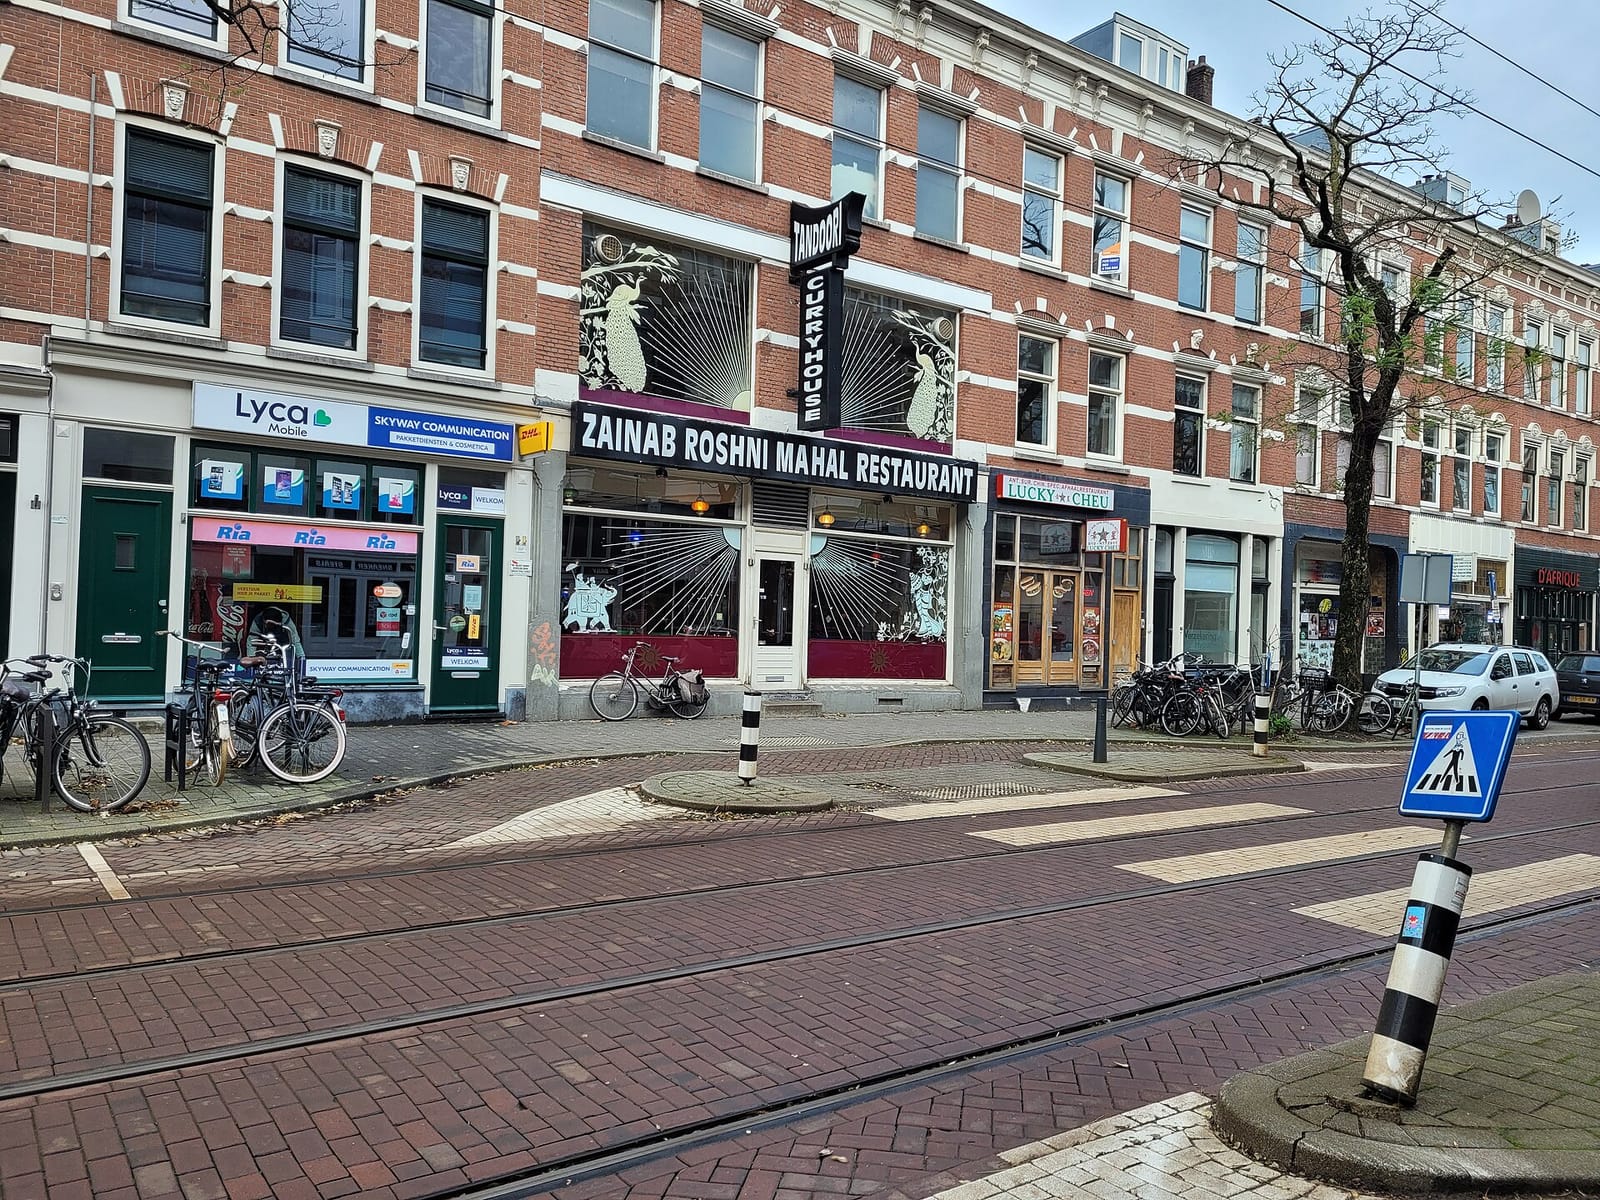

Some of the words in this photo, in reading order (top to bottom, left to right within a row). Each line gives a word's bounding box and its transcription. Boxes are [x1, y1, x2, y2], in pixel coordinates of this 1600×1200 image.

[793, 200, 842, 263] TANDOORI
[236, 392, 308, 427] Lyca
[268, 422, 307, 437] Mobile
[374, 415, 421, 429] SKYWAY
[422, 421, 510, 441] COMMUNICATION
[521, 428, 539, 440] DHL
[395, 434, 448, 446] PAKKETDIENSTEN
[455, 441, 489, 451] COSMETICA
[582, 413, 675, 457] ZAINAB
[684, 427, 768, 470] ROSHNI
[775, 441, 849, 481] MAHAL
[856, 452, 974, 495] RESTAURANT
[439, 489, 461, 500] Lyca
[475, 496, 504, 505] WELKOM
[1008, 483, 1056, 502] LUCKY
[1072, 492, 1109, 508] CHEU
[216, 523, 251, 541] Ria
[294, 528, 327, 546] Ria
[365, 533, 396, 550] Ria
[461, 559, 475, 568] Ria
[1538, 568, 1581, 588] D'AFRIQUE
